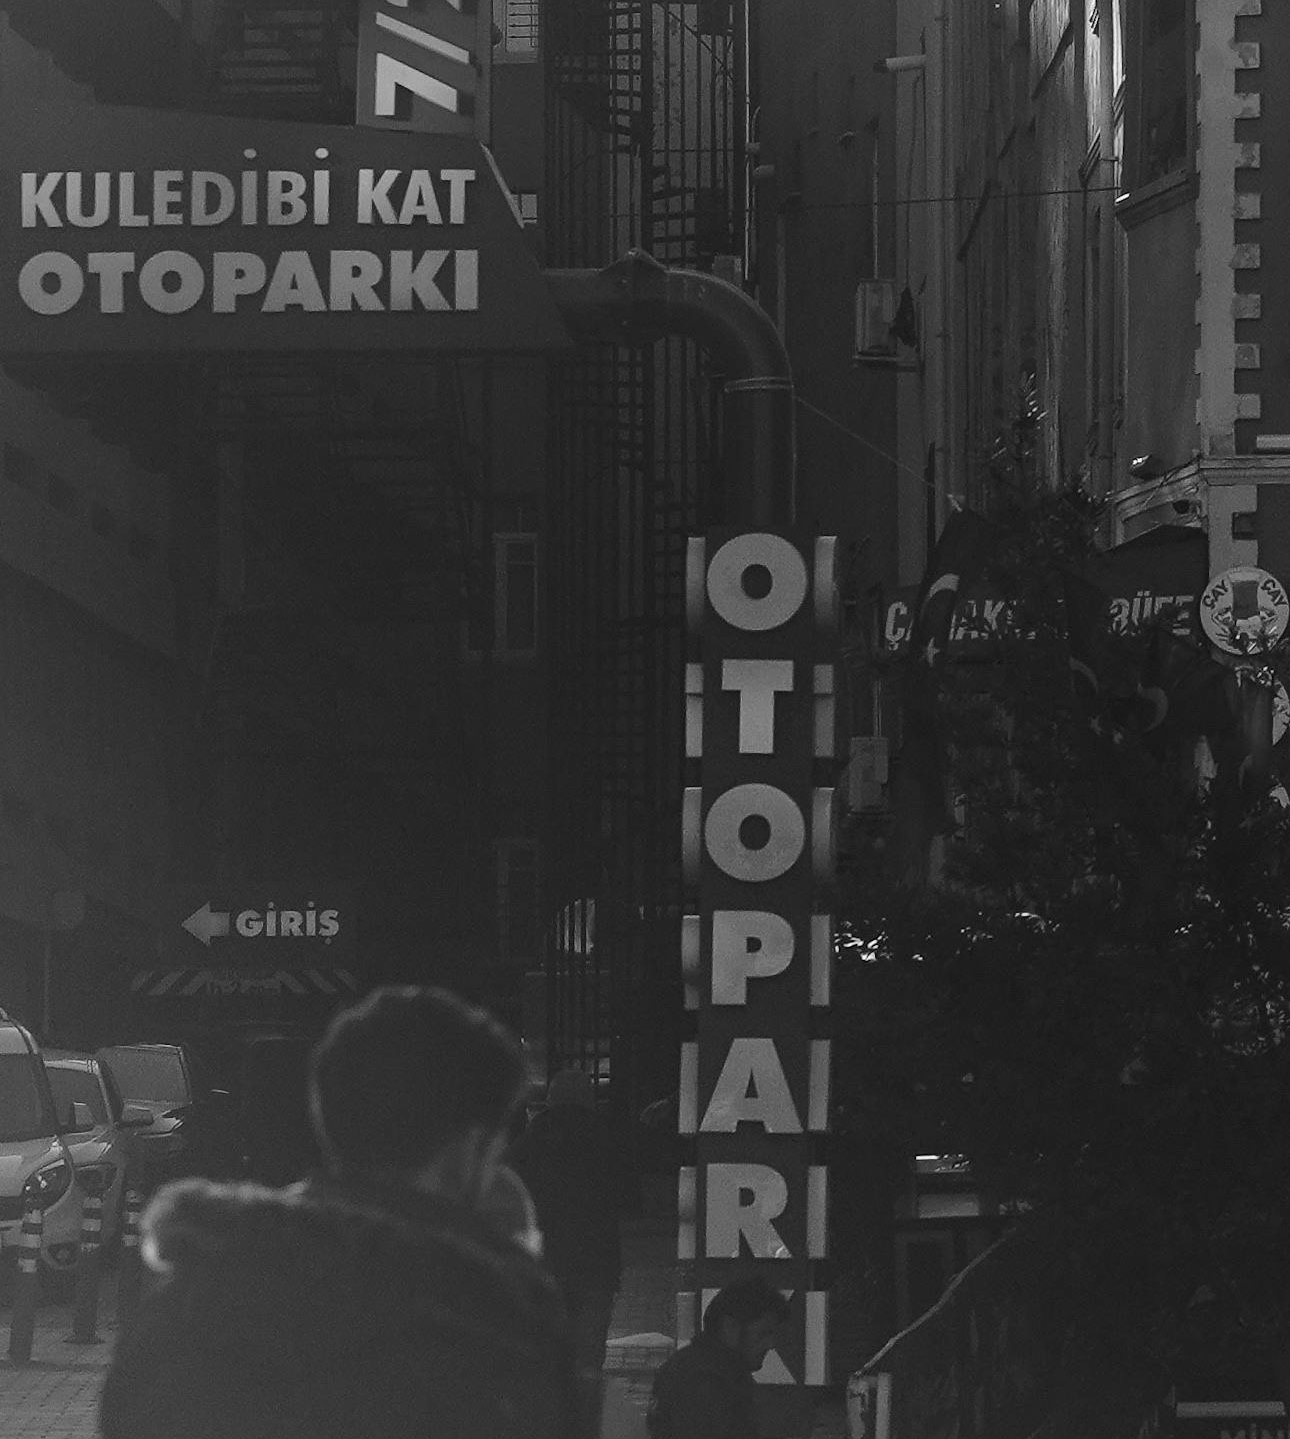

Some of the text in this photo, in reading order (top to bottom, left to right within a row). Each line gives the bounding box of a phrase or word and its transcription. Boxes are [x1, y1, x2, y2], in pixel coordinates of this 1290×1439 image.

[20, 147, 477, 229] KULEDİBİ KAT
[17, 249, 480, 316] OTOPARKI
[1202, 578, 1229, 610] ÇAY
[1260, 578, 1288, 608] ÇAY
[235, 900, 341, 945] GİRİŞ
